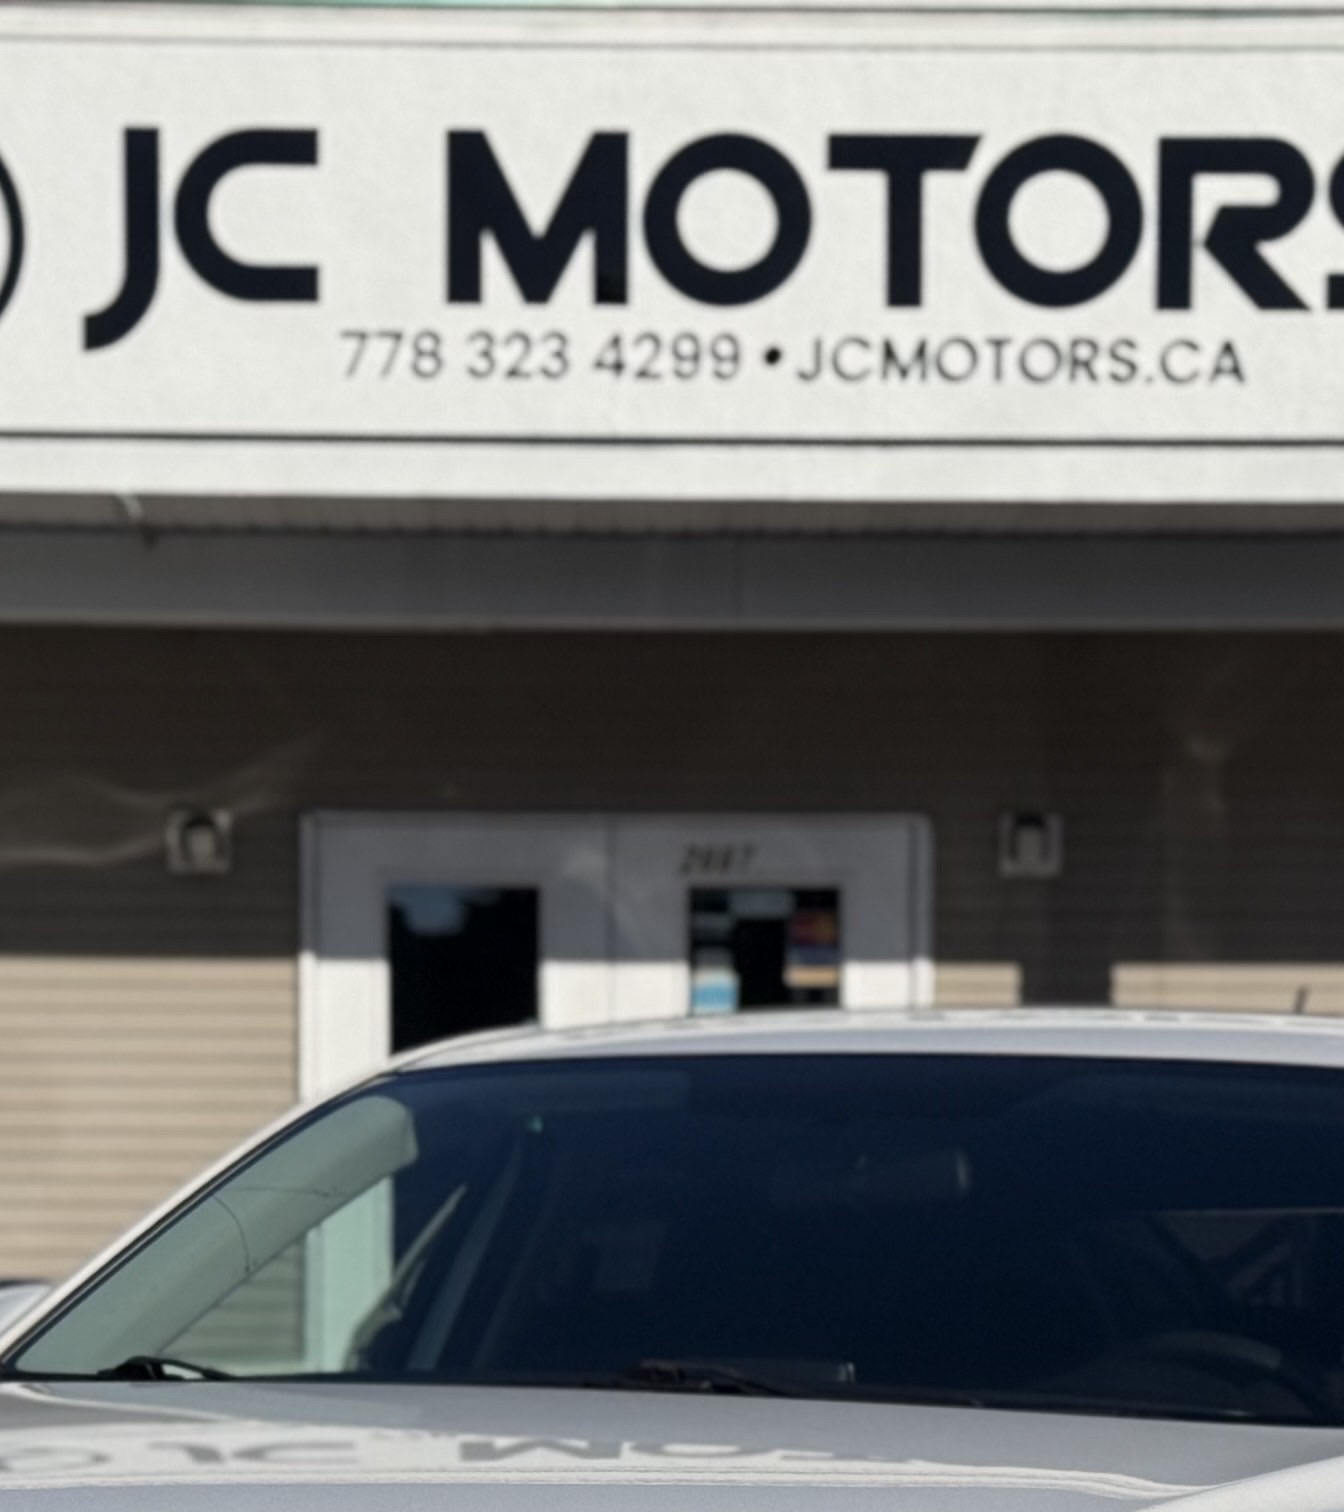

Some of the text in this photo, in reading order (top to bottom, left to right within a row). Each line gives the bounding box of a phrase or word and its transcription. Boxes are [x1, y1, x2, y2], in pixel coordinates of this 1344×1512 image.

[84, 127, 319, 351] JC
[340, 331, 1248, 386] 778 323 4299 JCMOTORS.CA
